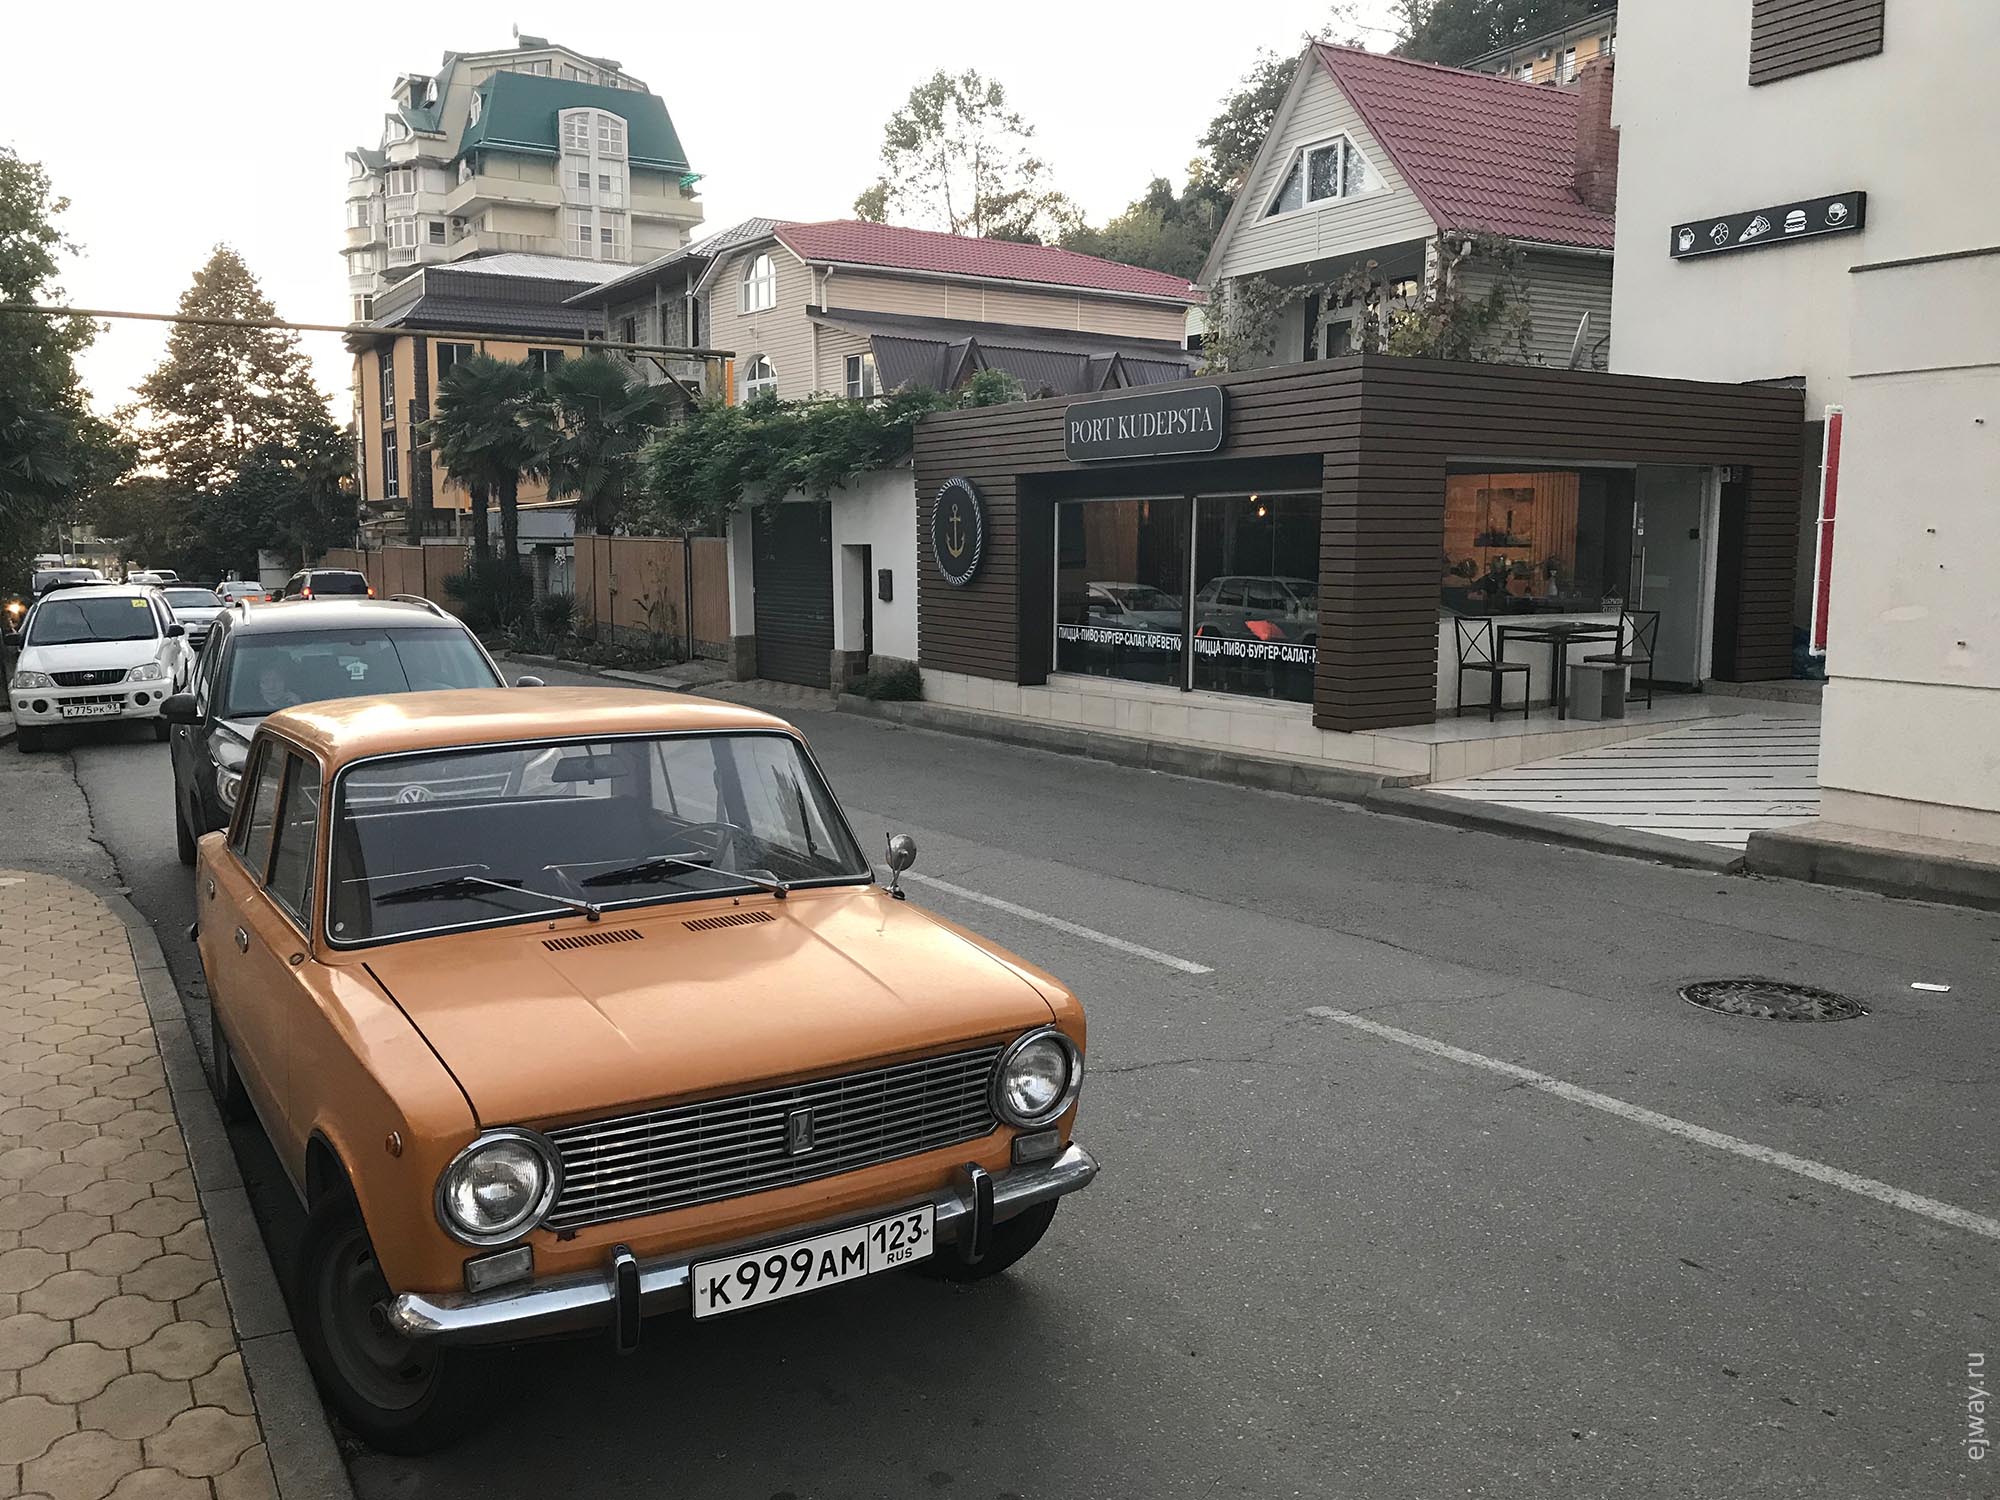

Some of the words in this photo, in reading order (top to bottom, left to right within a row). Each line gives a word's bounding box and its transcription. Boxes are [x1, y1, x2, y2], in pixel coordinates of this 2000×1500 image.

[1071, 417, 1114, 443] PORT
[1118, 406, 1213, 439] KUDEPSTA
[871, 1213, 922, 1255] 123
[887, 1247, 913, 1265] RUS
